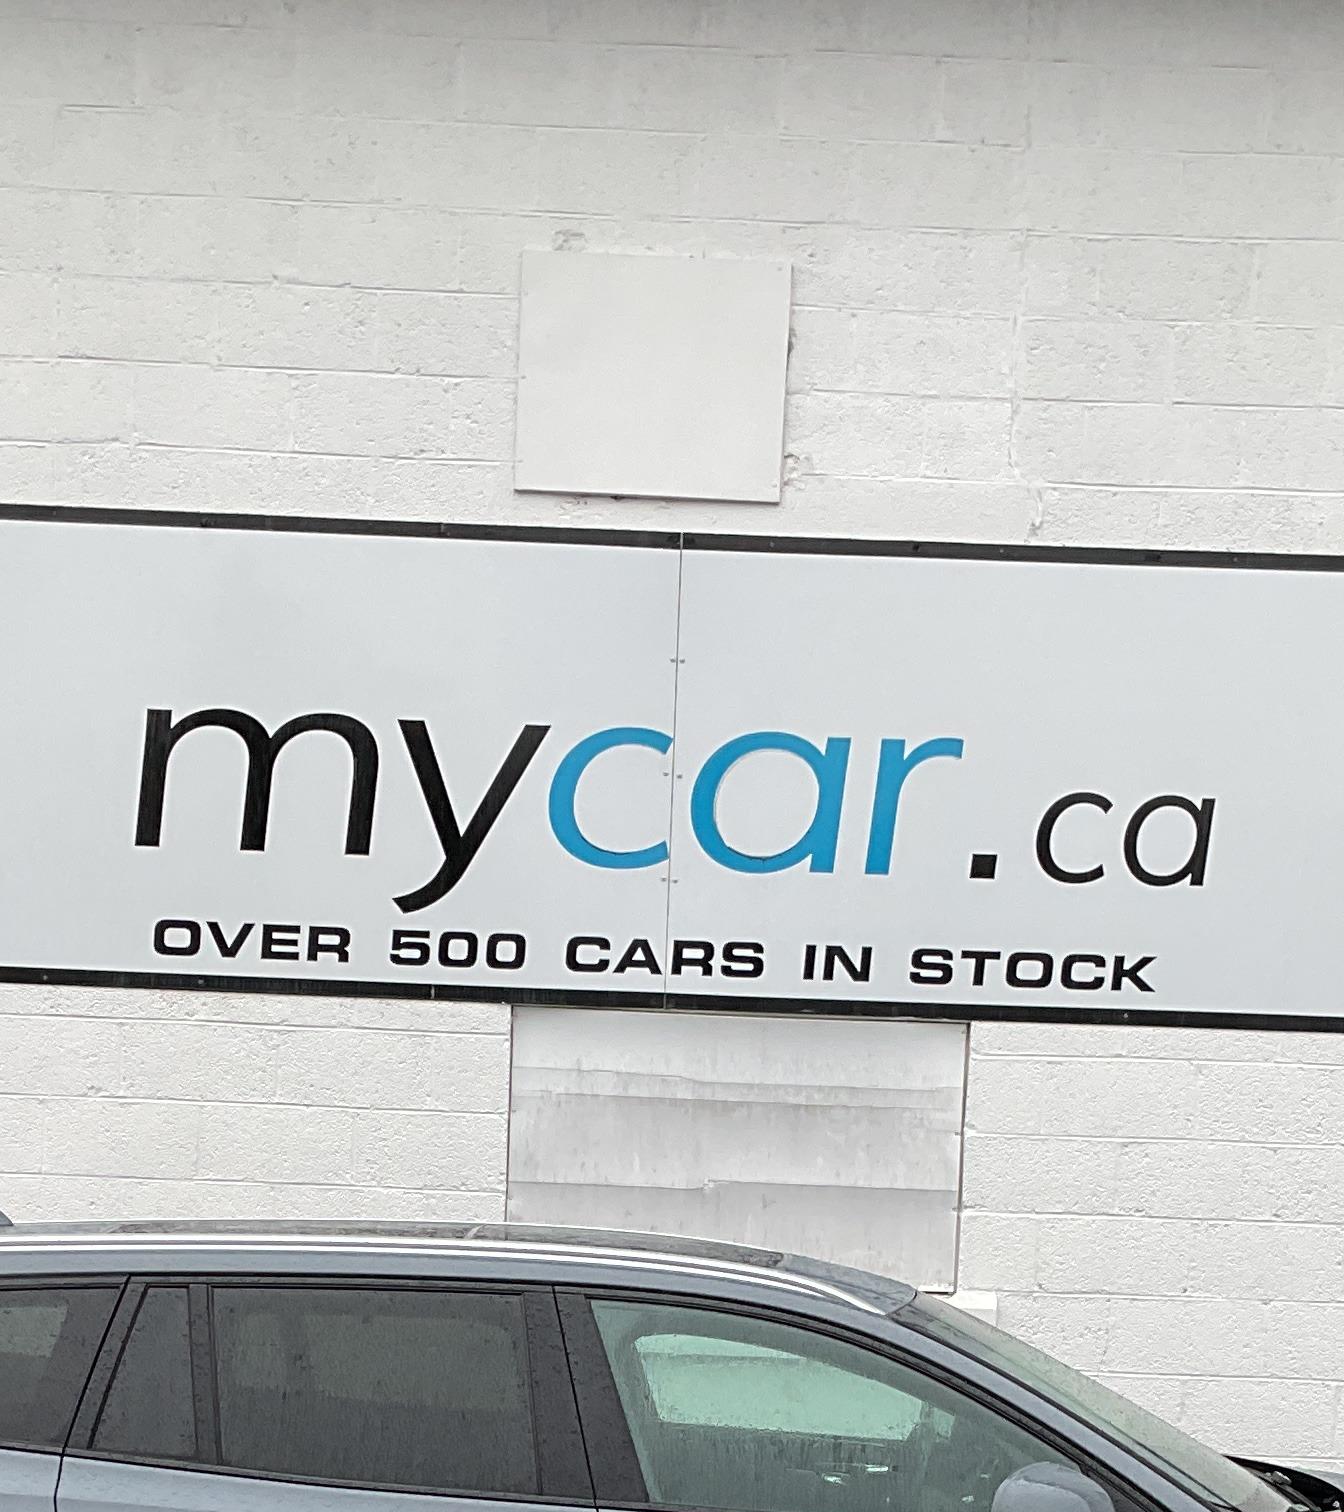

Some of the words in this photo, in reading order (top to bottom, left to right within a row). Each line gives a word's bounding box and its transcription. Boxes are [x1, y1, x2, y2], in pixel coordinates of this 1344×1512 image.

[133, 706, 1216, 915] mycar.ca
[152, 920, 351, 963] OVER
[389, 930, 527, 970] 500
[565, 936, 765, 978] CARS
[803, 944, 871, 983] IN
[909, 949, 1158, 993] STOCK
